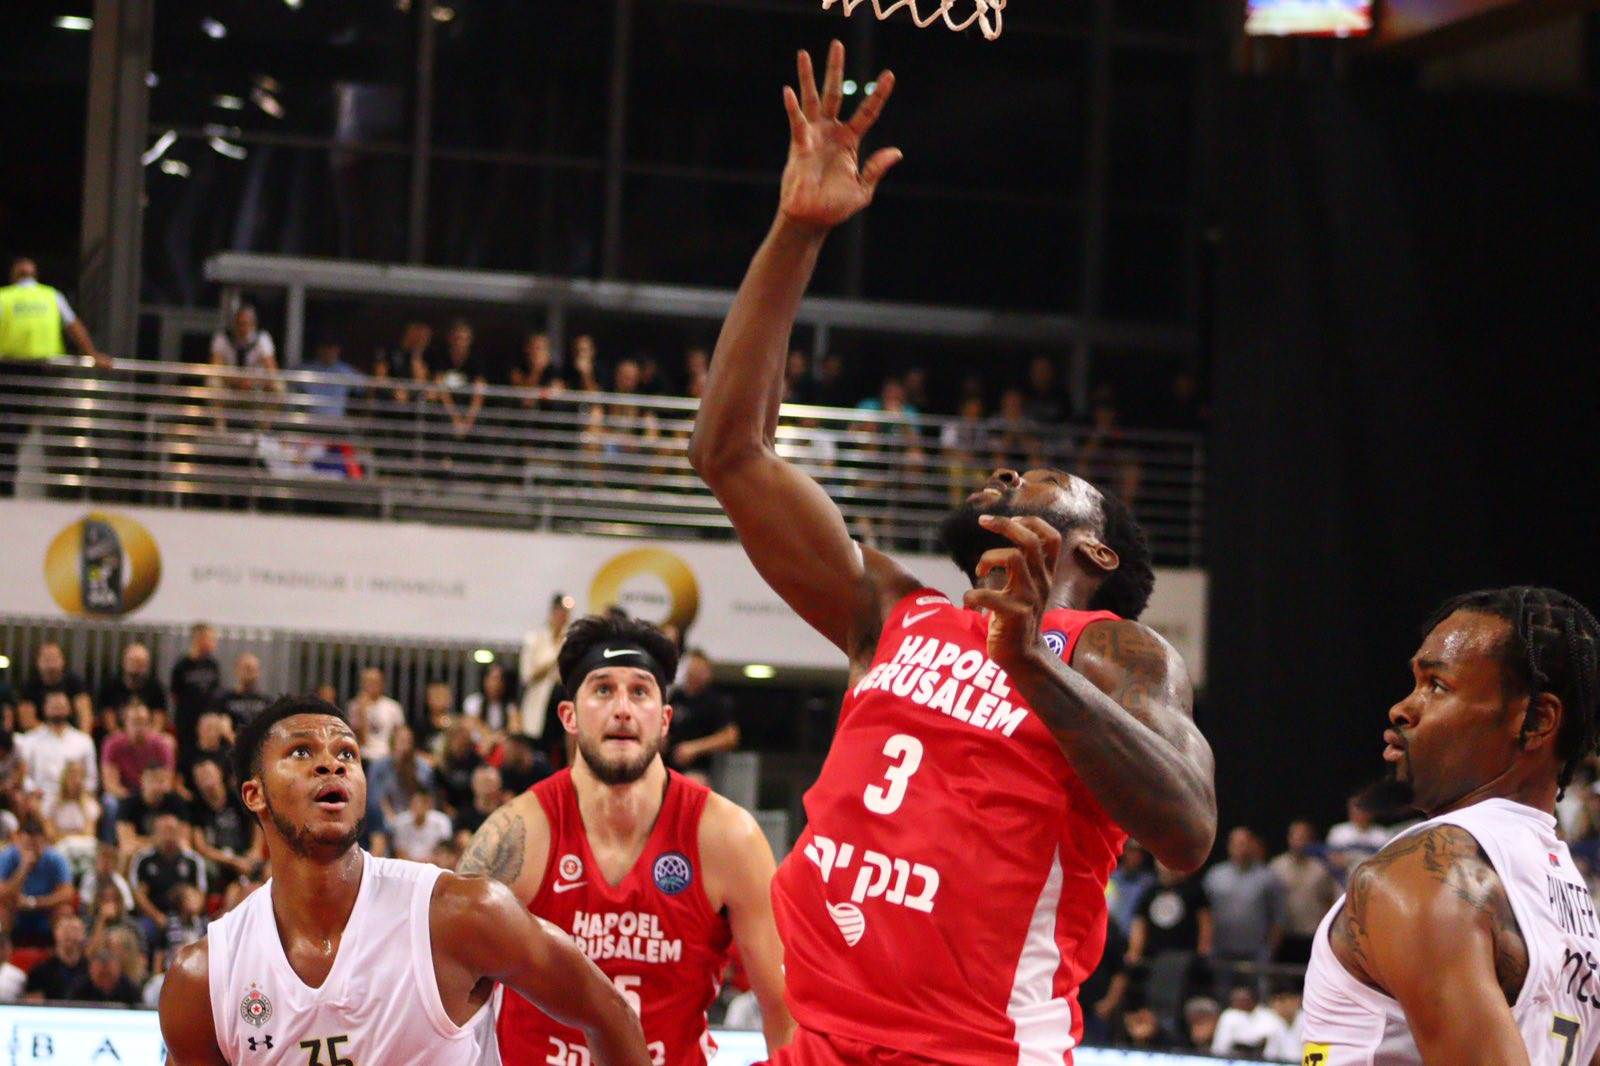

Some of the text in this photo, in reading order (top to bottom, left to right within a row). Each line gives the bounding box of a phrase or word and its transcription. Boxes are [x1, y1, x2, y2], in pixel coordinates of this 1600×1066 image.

[893, 635, 1011, 697] HAPOEL
[863, 733, 924, 815] 3
[851, 850, 940, 913] בנק
[572, 911, 664, 939] HAPOEL
